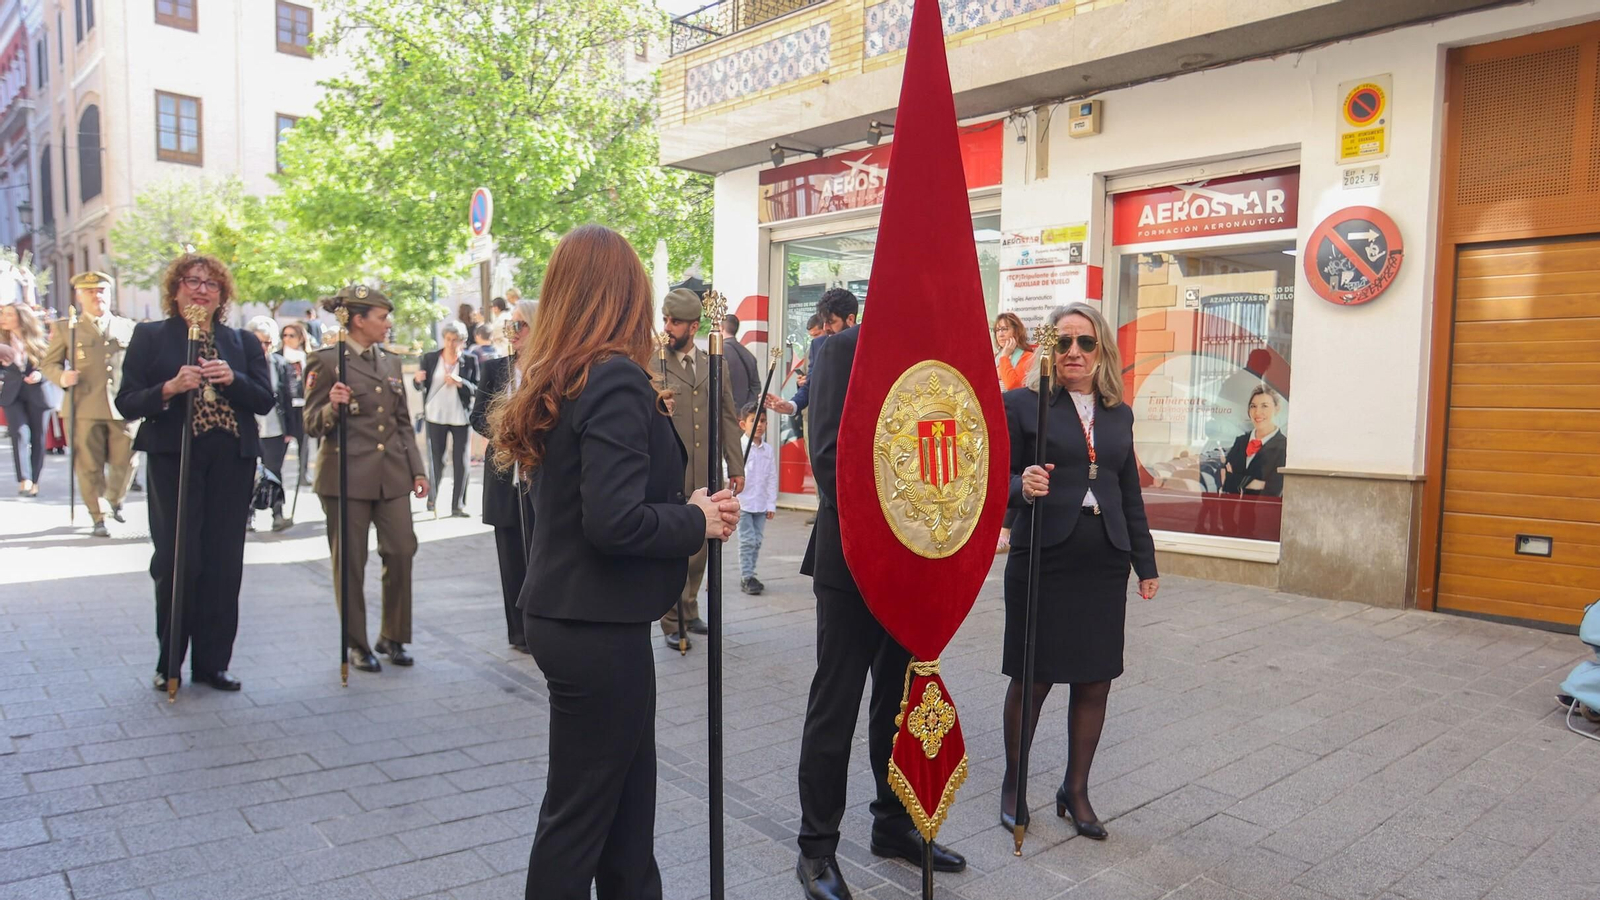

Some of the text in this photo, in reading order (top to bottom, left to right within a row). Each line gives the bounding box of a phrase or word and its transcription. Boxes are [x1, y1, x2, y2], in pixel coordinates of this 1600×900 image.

[1344, 175, 1365, 186] 2025
[1138, 189, 1285, 228] AEROSTAR
[1138, 216, 1284, 237] FORMACIÓN AERONÁUTICA
[1016, 258, 1034, 266] AESA
[1209, 295, 1258, 303] AZAFATOS/AS
